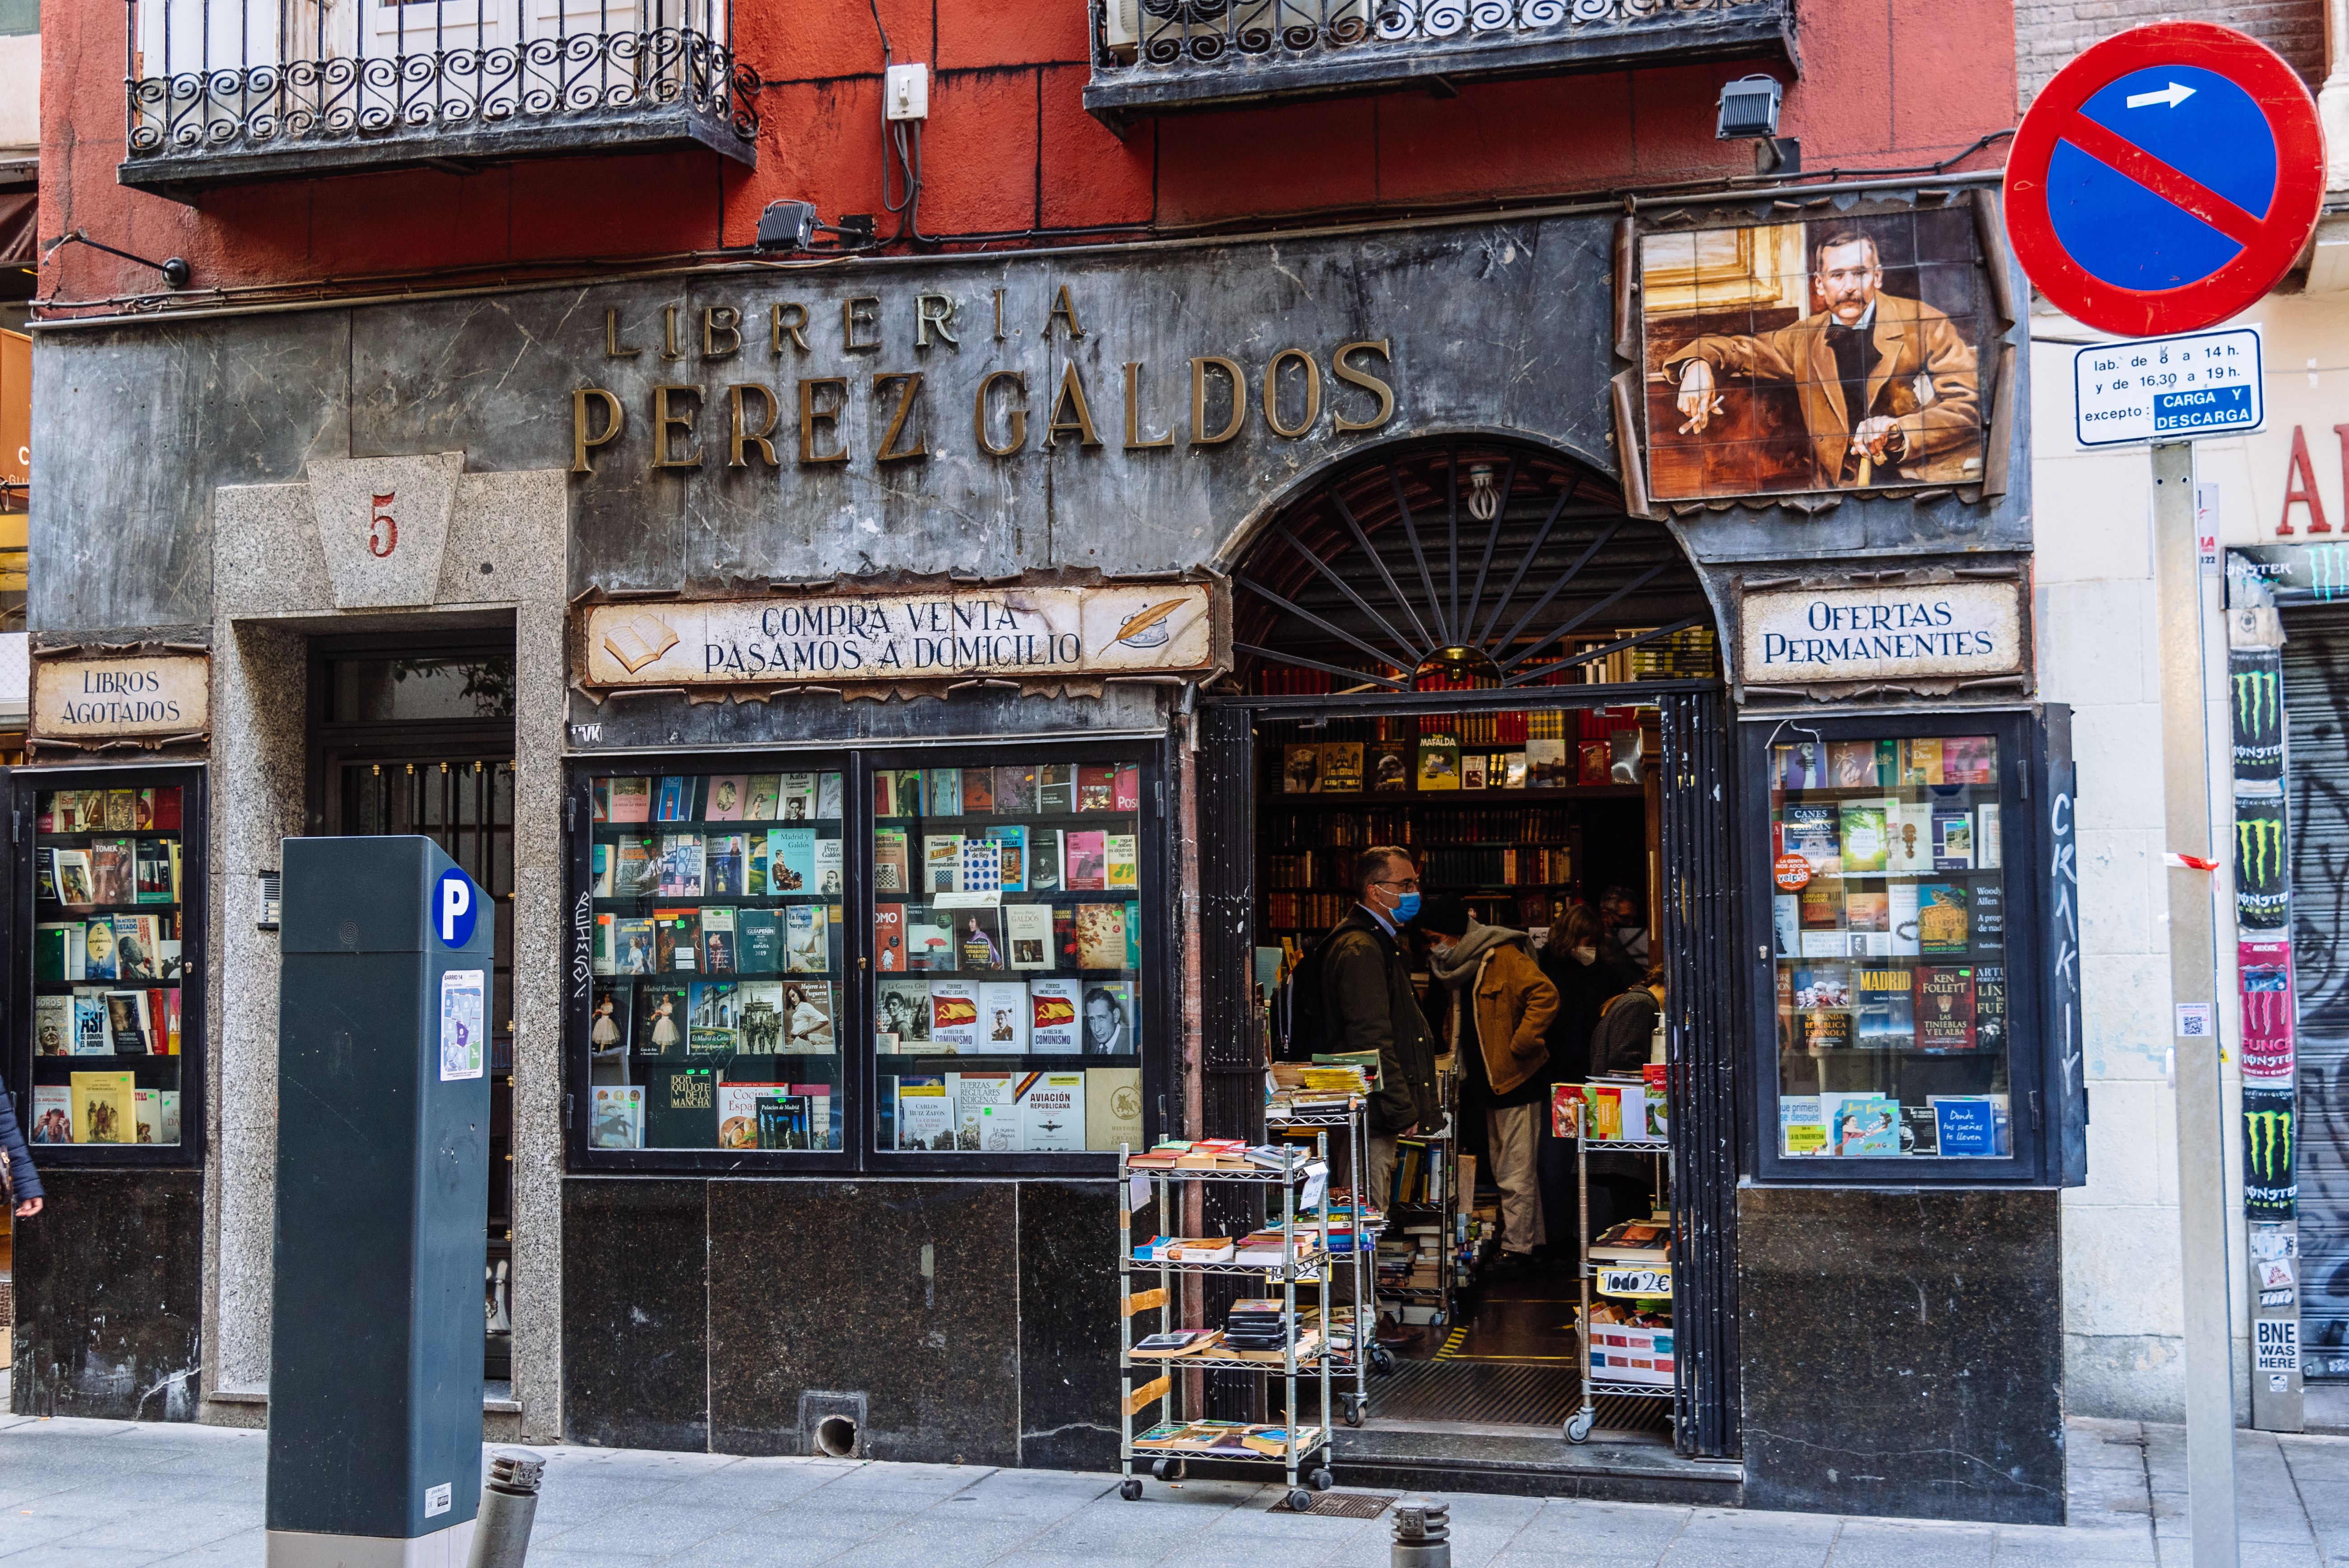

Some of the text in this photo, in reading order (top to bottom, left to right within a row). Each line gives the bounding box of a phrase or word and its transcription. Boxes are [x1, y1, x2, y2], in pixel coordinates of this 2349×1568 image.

[606, 284, 1086, 360] LIBRERIA
[2094, 359, 2119, 372] lab.
[2131, 356, 2147, 368] de
[2183, 352, 2190, 361] a
[2204, 346, 2221, 359] 14
[2227, 345, 2239, 357] h.
[2096, 366, 2240, 394] y de 16,30 a 19 h.
[2163, 391, 2215, 407] CARGA
[2232, 388, 2241, 401] Y
[571, 338, 1396, 473] PEREZ GALDOS
[2157, 408, 2249, 430] DESCARGA
[370, 491, 398, 558] 5
[762, 600, 1020, 639] COMPRA VENTA
[1808, 601, 1951, 632] OFERTAS
[704, 633, 1081, 673] PASAMOS A DOMICILIO
[1762, 630, 1993, 665] PERMANENTES
[83, 670, 159, 695] LIBROS
[61, 701, 180, 725] AGOTADOS
[1420, 738, 1456, 746] MAFALDA
[1795, 810, 1827, 818] CANES
[931, 846, 957, 858] AJEDREZ
[1778, 873, 1797, 882] yelp
[1976, 887, 2002, 896] Woody
[443, 879, 469, 940] P
[1860, 971, 1911, 991] MADRID
[1934, 974, 1955, 983] KEN
[1923, 983, 1966, 993] FOLLETT
[36, 998, 62, 1006] SOROS
[81, 1006, 103, 1033] ASÍ
[936, 1035, 972, 1044] COMUNISMO
[1035, 1035, 1070, 1044] COMUNISMO
[672, 1083, 710, 1095] QUIJOTE
[685, 1091, 709, 1099] DE LA
[672, 1098, 709, 1106] MANCHA
[1030, 1091, 1070, 1101] AVIACIÓN
[1792, 1104, 1818, 1113] primero
[1950, 1109, 1974, 1120] Donde
[1791, 1113, 1819, 1123] después
[1957, 1122, 1983, 1131] sueños
[1956, 1133, 1981, 1141] lleven
[1601, 1271, 1670, 1293] Todo 2€
[2261, 1293, 2293, 1305] KOKO
[2259, 1323, 2296, 1343] BNE
[2259, 1345, 2296, 1356] WAS
[2259, 1357, 2296, 1368] HERE
